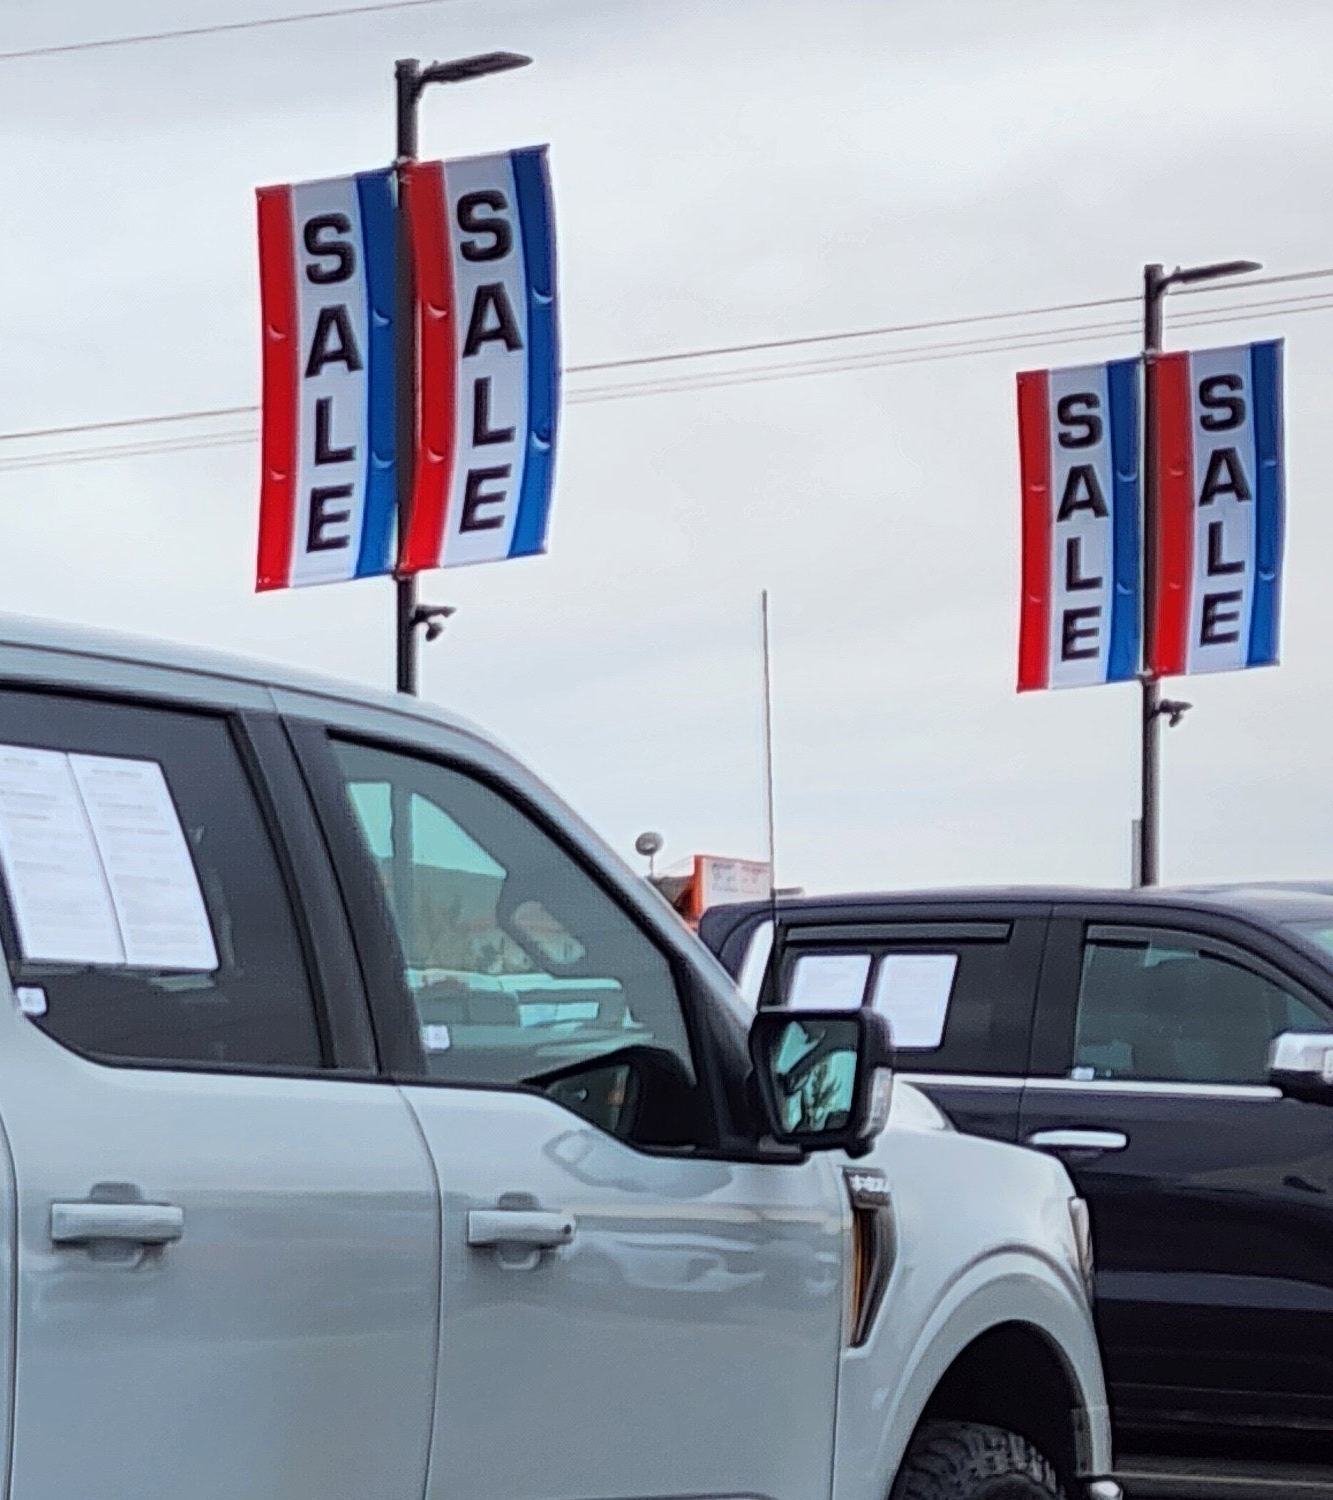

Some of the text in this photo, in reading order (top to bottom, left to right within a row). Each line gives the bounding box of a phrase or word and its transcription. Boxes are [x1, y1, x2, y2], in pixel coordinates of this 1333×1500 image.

[303, 212, 364, 554] SALE
[455, 189, 525, 534] SALE
[1198, 373, 1253, 648] SALE
[1056, 391, 1110, 662] SALE
